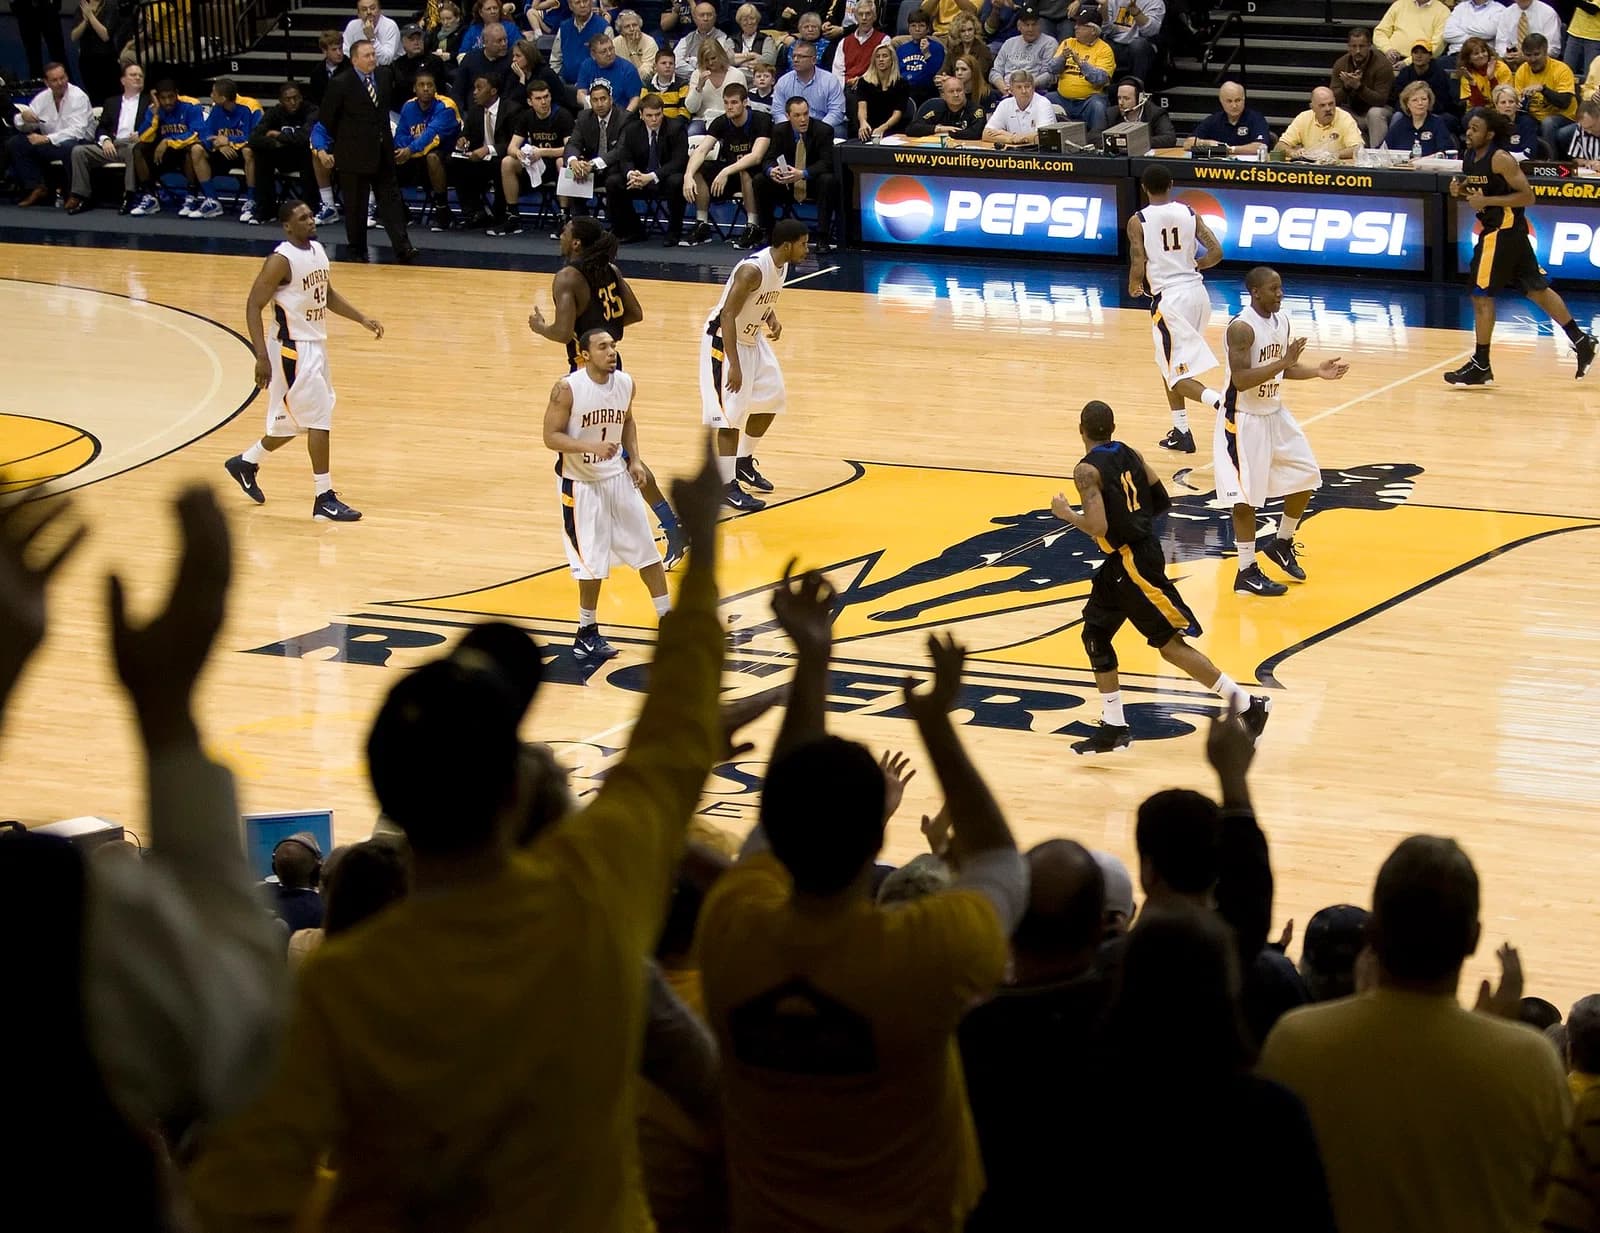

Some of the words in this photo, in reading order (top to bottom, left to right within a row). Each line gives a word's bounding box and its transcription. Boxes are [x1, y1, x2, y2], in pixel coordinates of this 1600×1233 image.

[1247, 1, 1257, 12] D
[231, 61, 240, 72] B
[1160, 97, 1170, 108] B
[894, 152, 1074, 173] www.yourlifeyourbank.com
[1194, 166, 1373, 188] www.cfsbcenter.com
[943, 190, 1102, 240] PEPSI
[1160, 227, 1182, 252] 11
[1238, 204, 1408, 257] PEPSI
[598, 281, 624, 321] 35
[601, 426, 608, 442] 1
[1120, 470, 1141, 513] 11
